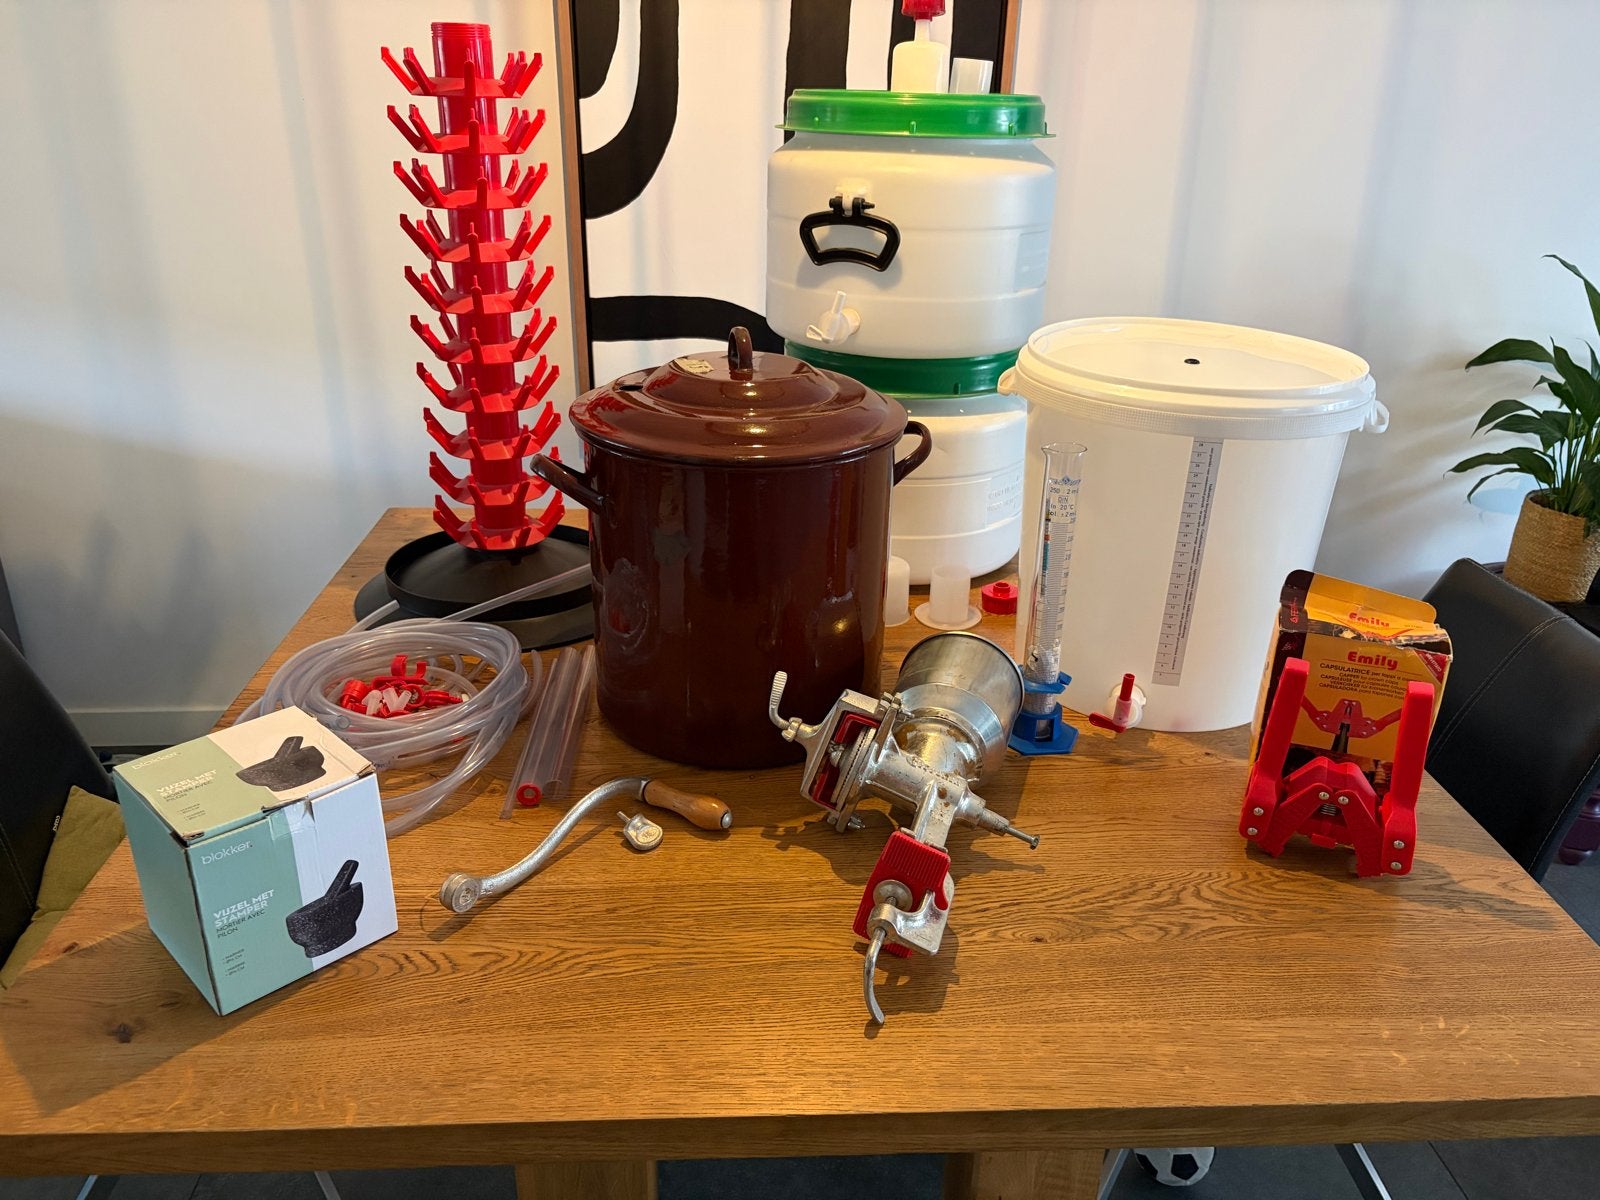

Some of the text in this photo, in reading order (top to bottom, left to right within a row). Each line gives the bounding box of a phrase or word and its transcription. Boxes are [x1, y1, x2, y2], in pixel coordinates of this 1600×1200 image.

[1347, 651, 1398, 671] Emily
[1320, 662, 1371, 676] CAPSULATRICE
[1339, 672, 1360, 680] CAPPER
[195, 769, 217, 780] MET
[251, 889, 274, 903] MET
[214, 900, 268, 928] STAMPER
[216, 909, 265, 933] MORTIER AVEC
[217, 926, 239, 938] PILON
